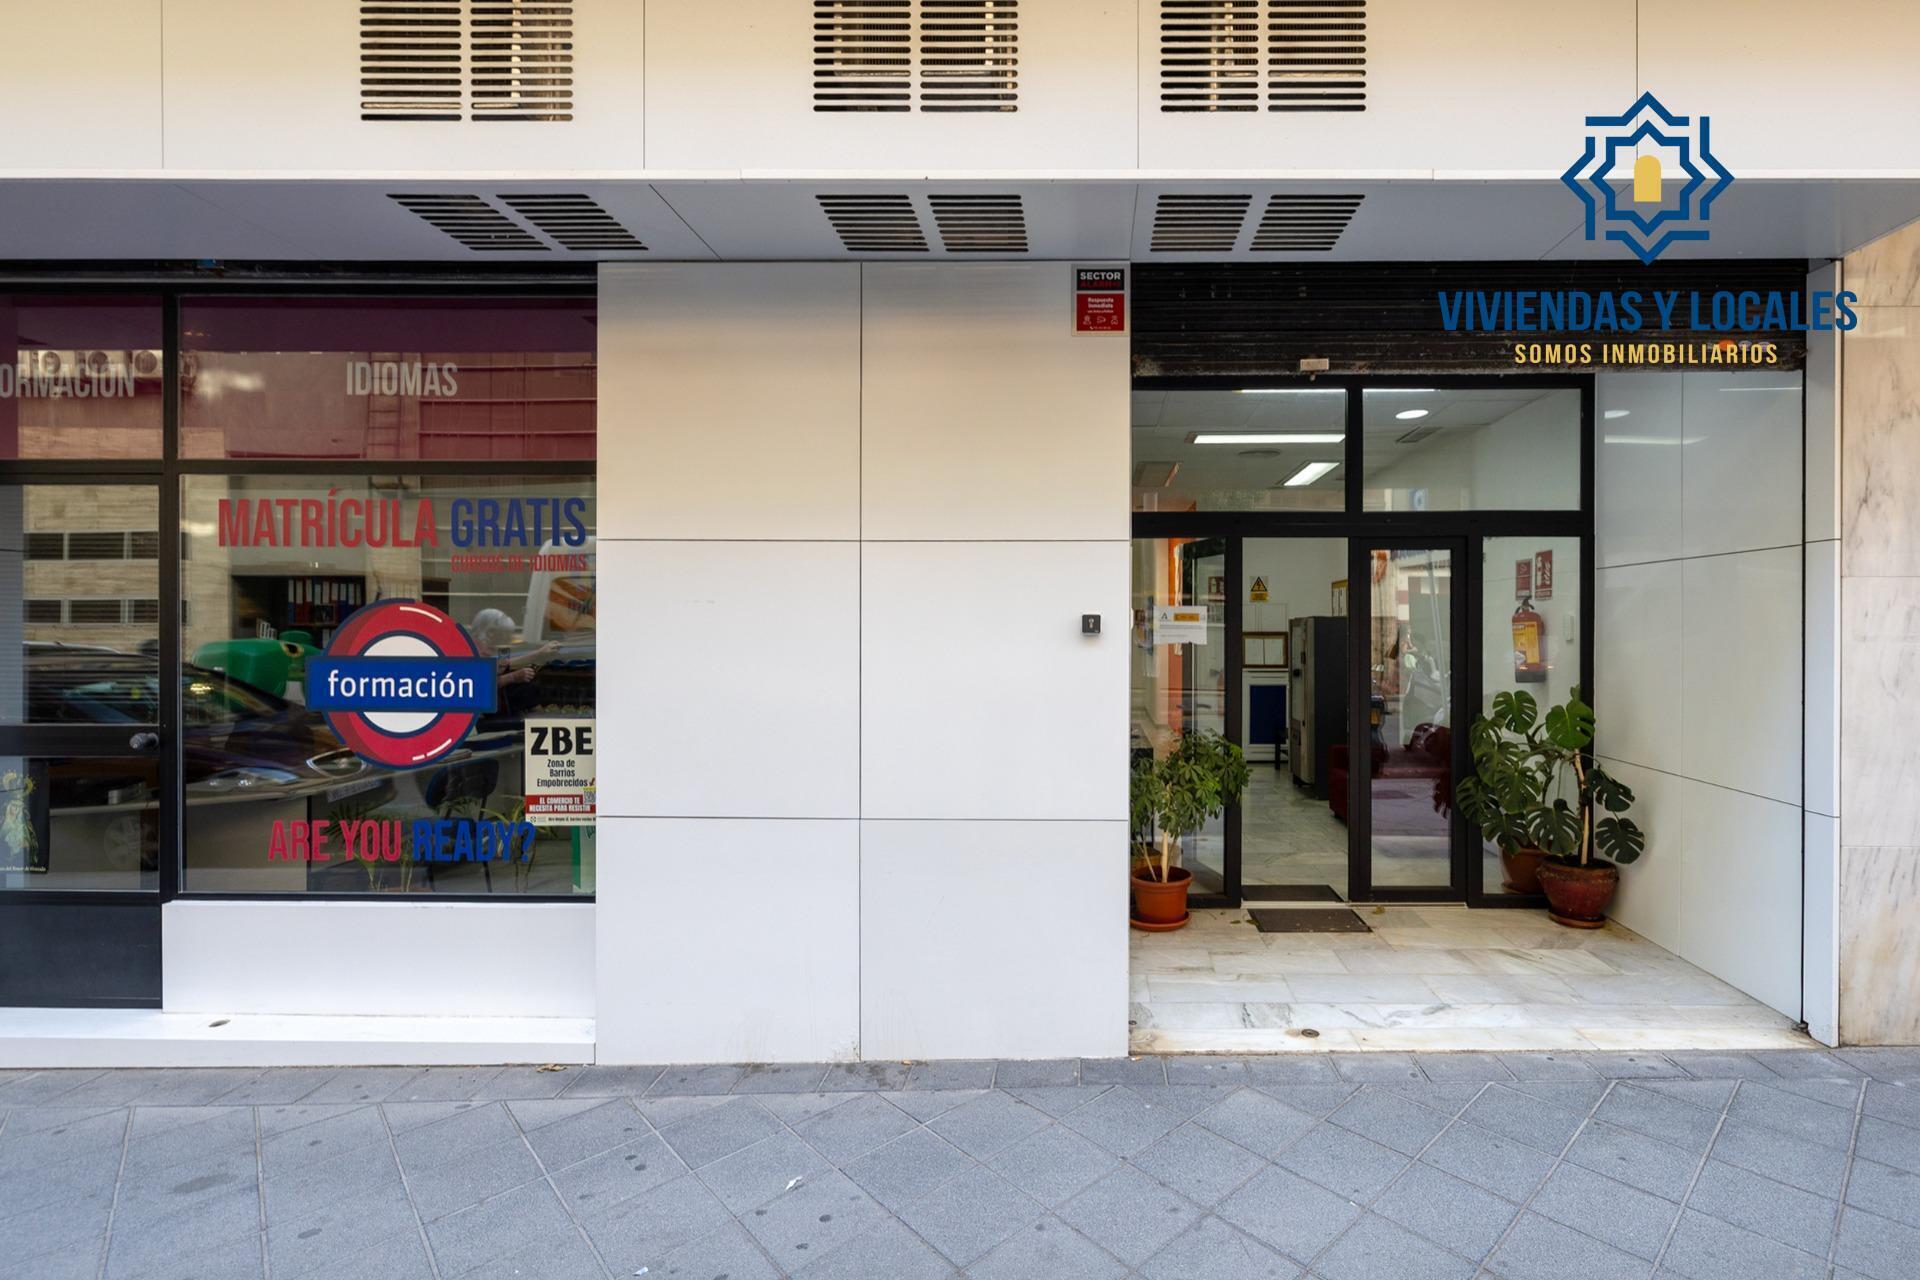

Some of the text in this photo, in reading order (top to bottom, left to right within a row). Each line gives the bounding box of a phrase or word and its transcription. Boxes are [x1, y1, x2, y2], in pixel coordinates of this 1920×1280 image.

[1080, 271, 1121, 280] SECTOR
[346, 362, 458, 396] IDIOMAS
[218, 487, 586, 548] MATRÍCULA GRATIS
[451, 553, 586, 573] CURSOS DE IDIOMAS
[328, 669, 474, 698] formación
[531, 727, 593, 755] ZBE
[547, 758, 576, 768] Zona de
[549, 768, 576, 777] Barrios
[537, 778, 588, 788] Empobrecidos
[554, 804, 567, 812] PARA
[268, 819, 536, 863] ARE YOU READY?
